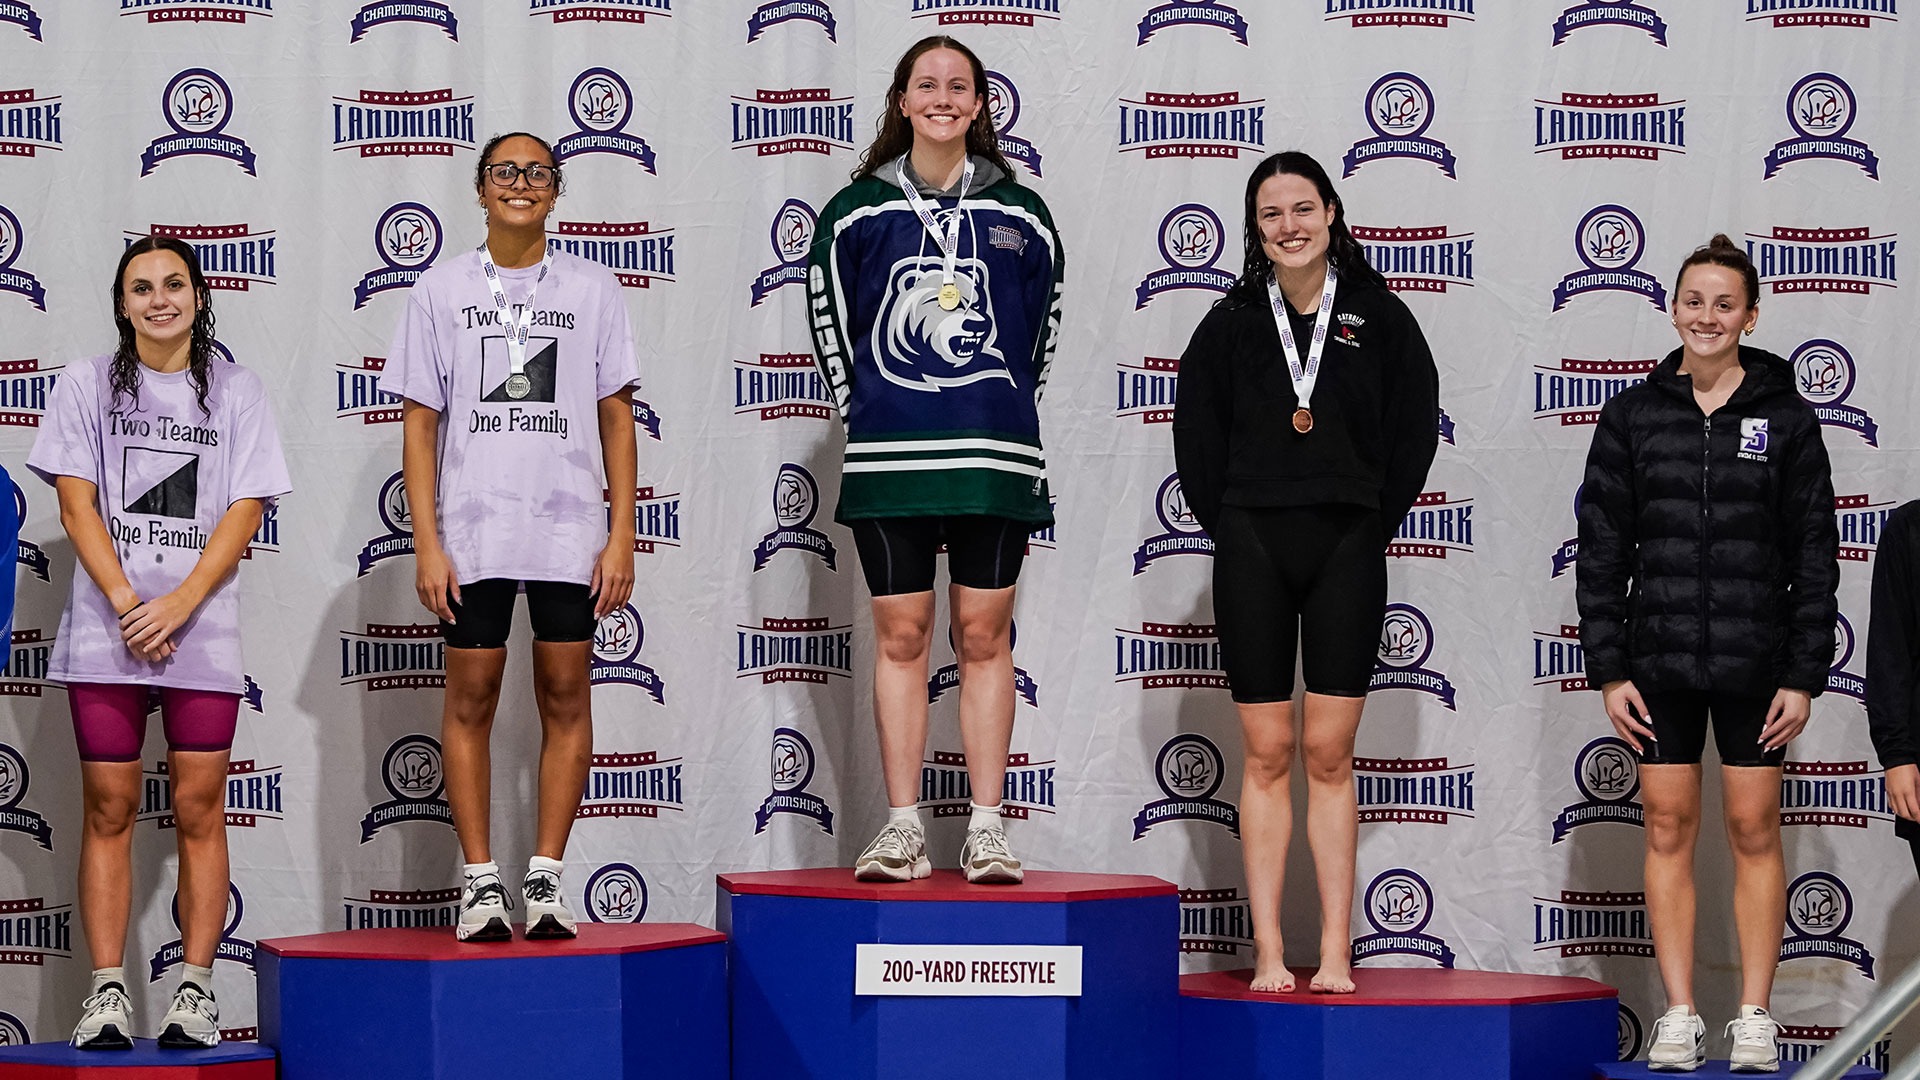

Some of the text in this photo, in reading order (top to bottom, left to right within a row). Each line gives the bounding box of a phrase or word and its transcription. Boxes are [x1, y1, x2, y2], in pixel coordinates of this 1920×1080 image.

[153, 10, 241, 22] CONFERENCE
[363, 4, 447, 23] CHAMPIONSHIPS
[558, 10, 641, 21] CONFERENCE
[943, 13, 1030, 24] CONFERENCE
[1149, 8, 1236, 27] CHAMPIONSHIPS
[1357, 15, 1444, 25] CONFERENCE
[1565, 8, 1655, 27] CHAMPIONSHIPS
[1778, 16, 1866, 25] CONFERENCE
[332, 103, 475, 144] LANDMARK
[731, 102, 855, 144] LANDMARK
[1118, 104, 1265, 147] LANDMARK
[1534, 106, 1687, 147] LANDMARK
[154, 137, 243, 157] CHAMPIONSHIPS
[365, 144, 450, 155] CONFERENCE
[560, 136, 644, 156] CHAMPIONSHIPS
[1150, 146, 1234, 156] CONFERENCE
[1355, 140, 1444, 160] CHAMPIONSHIPS
[1567, 147, 1655, 158] CONFERENCE
[1776, 140, 1866, 161] CHAMPIONSHIPS
[548, 234, 676, 276] NDMARK
[1363, 239, 1475, 280] DMARK
[366, 270, 422, 290] CHAMPION
[1147, 271, 1234, 291] CHAMPIONSHIPS
[1386, 280, 1442, 290] ERENCE
[1565, 271, 1655, 292] CHAMPIONSHIPS
[1777, 281, 1865, 292] CONFERENCE
[513, 304, 575, 330] Teams
[766, 405, 827, 417] COERENCE
[108, 411, 219, 447] Two Teams
[469, 408, 569, 440] One Family
[1740, 417, 1769, 454] S
[111, 516, 207, 555] One Family
[766, 531, 826, 552] CHPIONSHIPS
[1146, 536, 1216, 555] CHAMPIONSH
[1387, 545, 1442, 556] ERENCE
[340, 637, 447, 678] LANDMA
[372, 678, 447, 688] CONFEREN
[590, 666, 653, 685] MPIONSHIPS
[767, 671, 824, 681] CERENCE
[1147, 677, 1230, 687] CONFERENC
[1369, 671, 1443, 690] AMPIONSHIPS
[584, 764, 684, 804] DMARK
[1356, 771, 1475, 812] NDMARK
[373, 803, 452, 824] CHAMPIONSHIP
[766, 795, 822, 815] CPIONSHIPS
[1146, 803, 1234, 823] CHAMPIONSHIPS
[1565, 803, 1644, 824] CHAMPIONSHI
[1784, 814, 1863, 825] ONFERENCE
[1533, 903, 1653, 944] LANDMA
[1182, 942, 1232, 952] ERENCE
[1355, 937, 1443, 956] CHAMPIONSHIPS
[1566, 945, 1651, 955] CONFERENCE
[1780, 939, 1862, 960] HAMPIONSHIPS
[883, 960, 1056, 984] 200-YARD FREESTYLE
